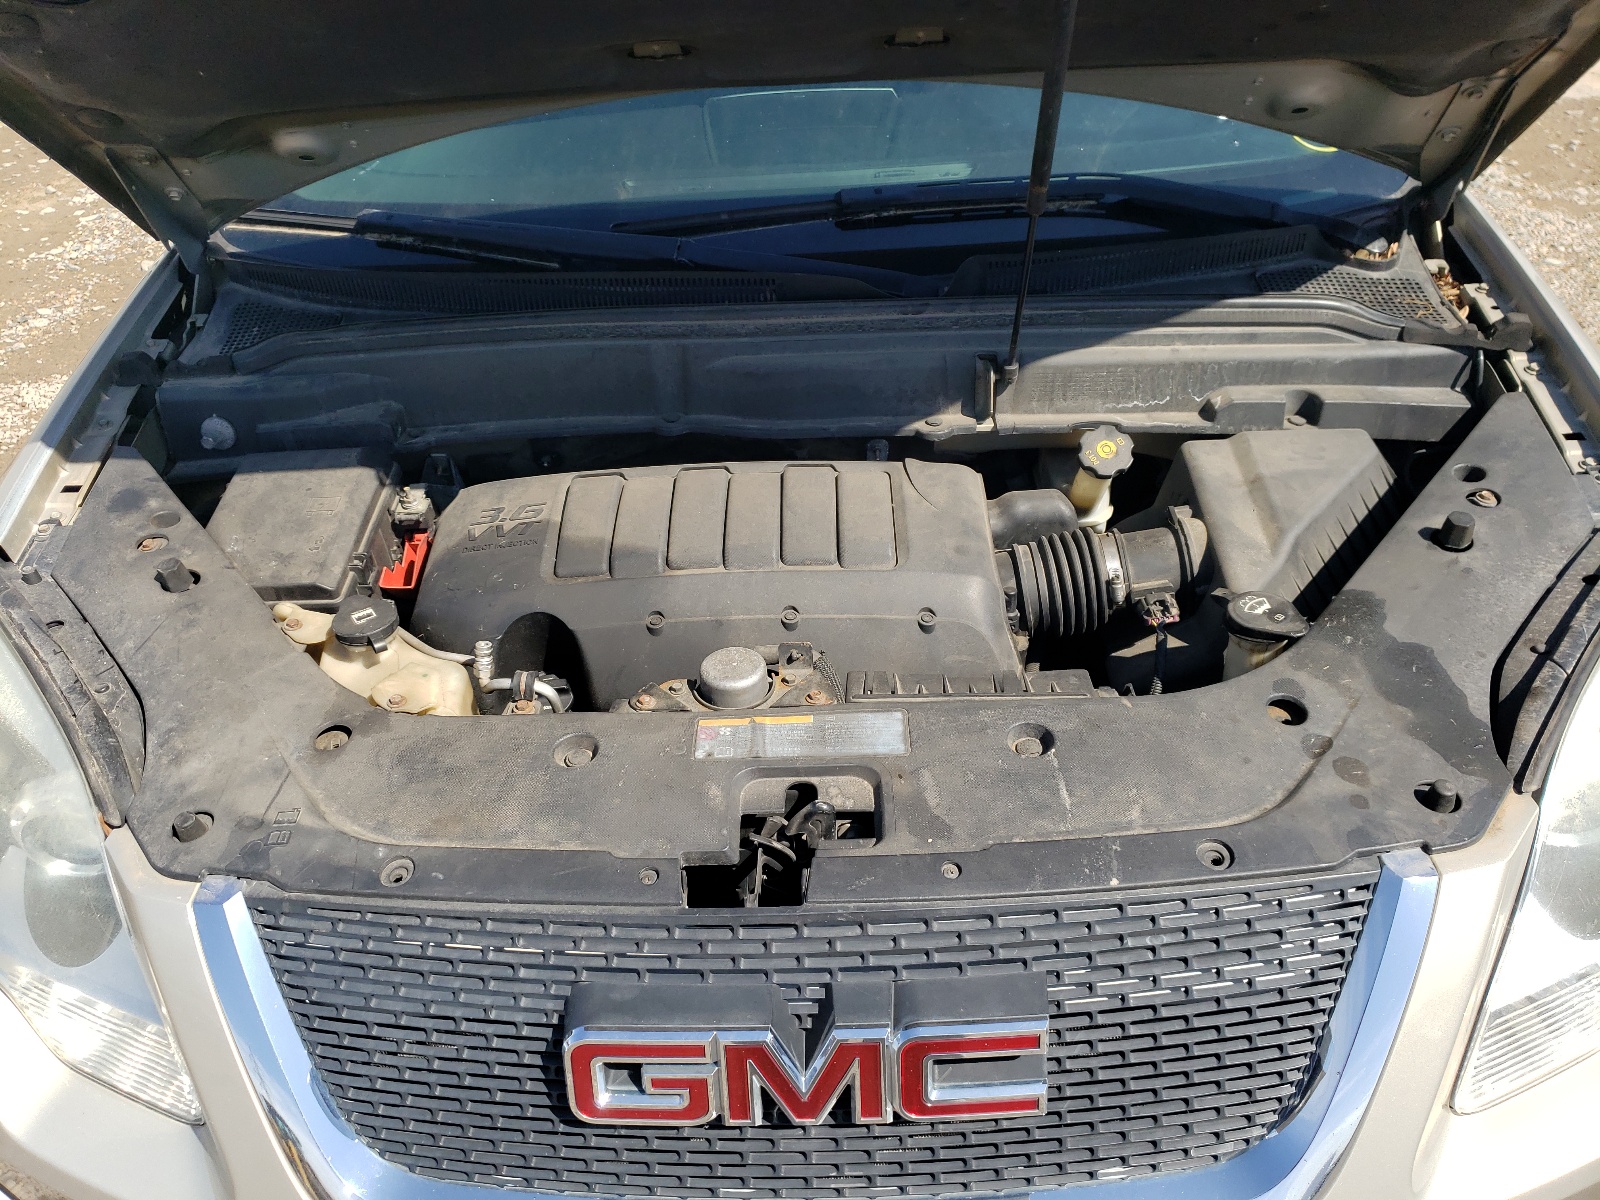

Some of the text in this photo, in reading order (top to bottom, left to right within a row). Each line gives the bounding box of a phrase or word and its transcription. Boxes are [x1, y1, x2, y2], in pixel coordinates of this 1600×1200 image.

[477, 502, 547, 524] 3.6
[468, 520, 541, 542] VVT
[462, 538, 539, 553] DIRECT INJECTION
[564, 1022, 1049, 1126] GMC
